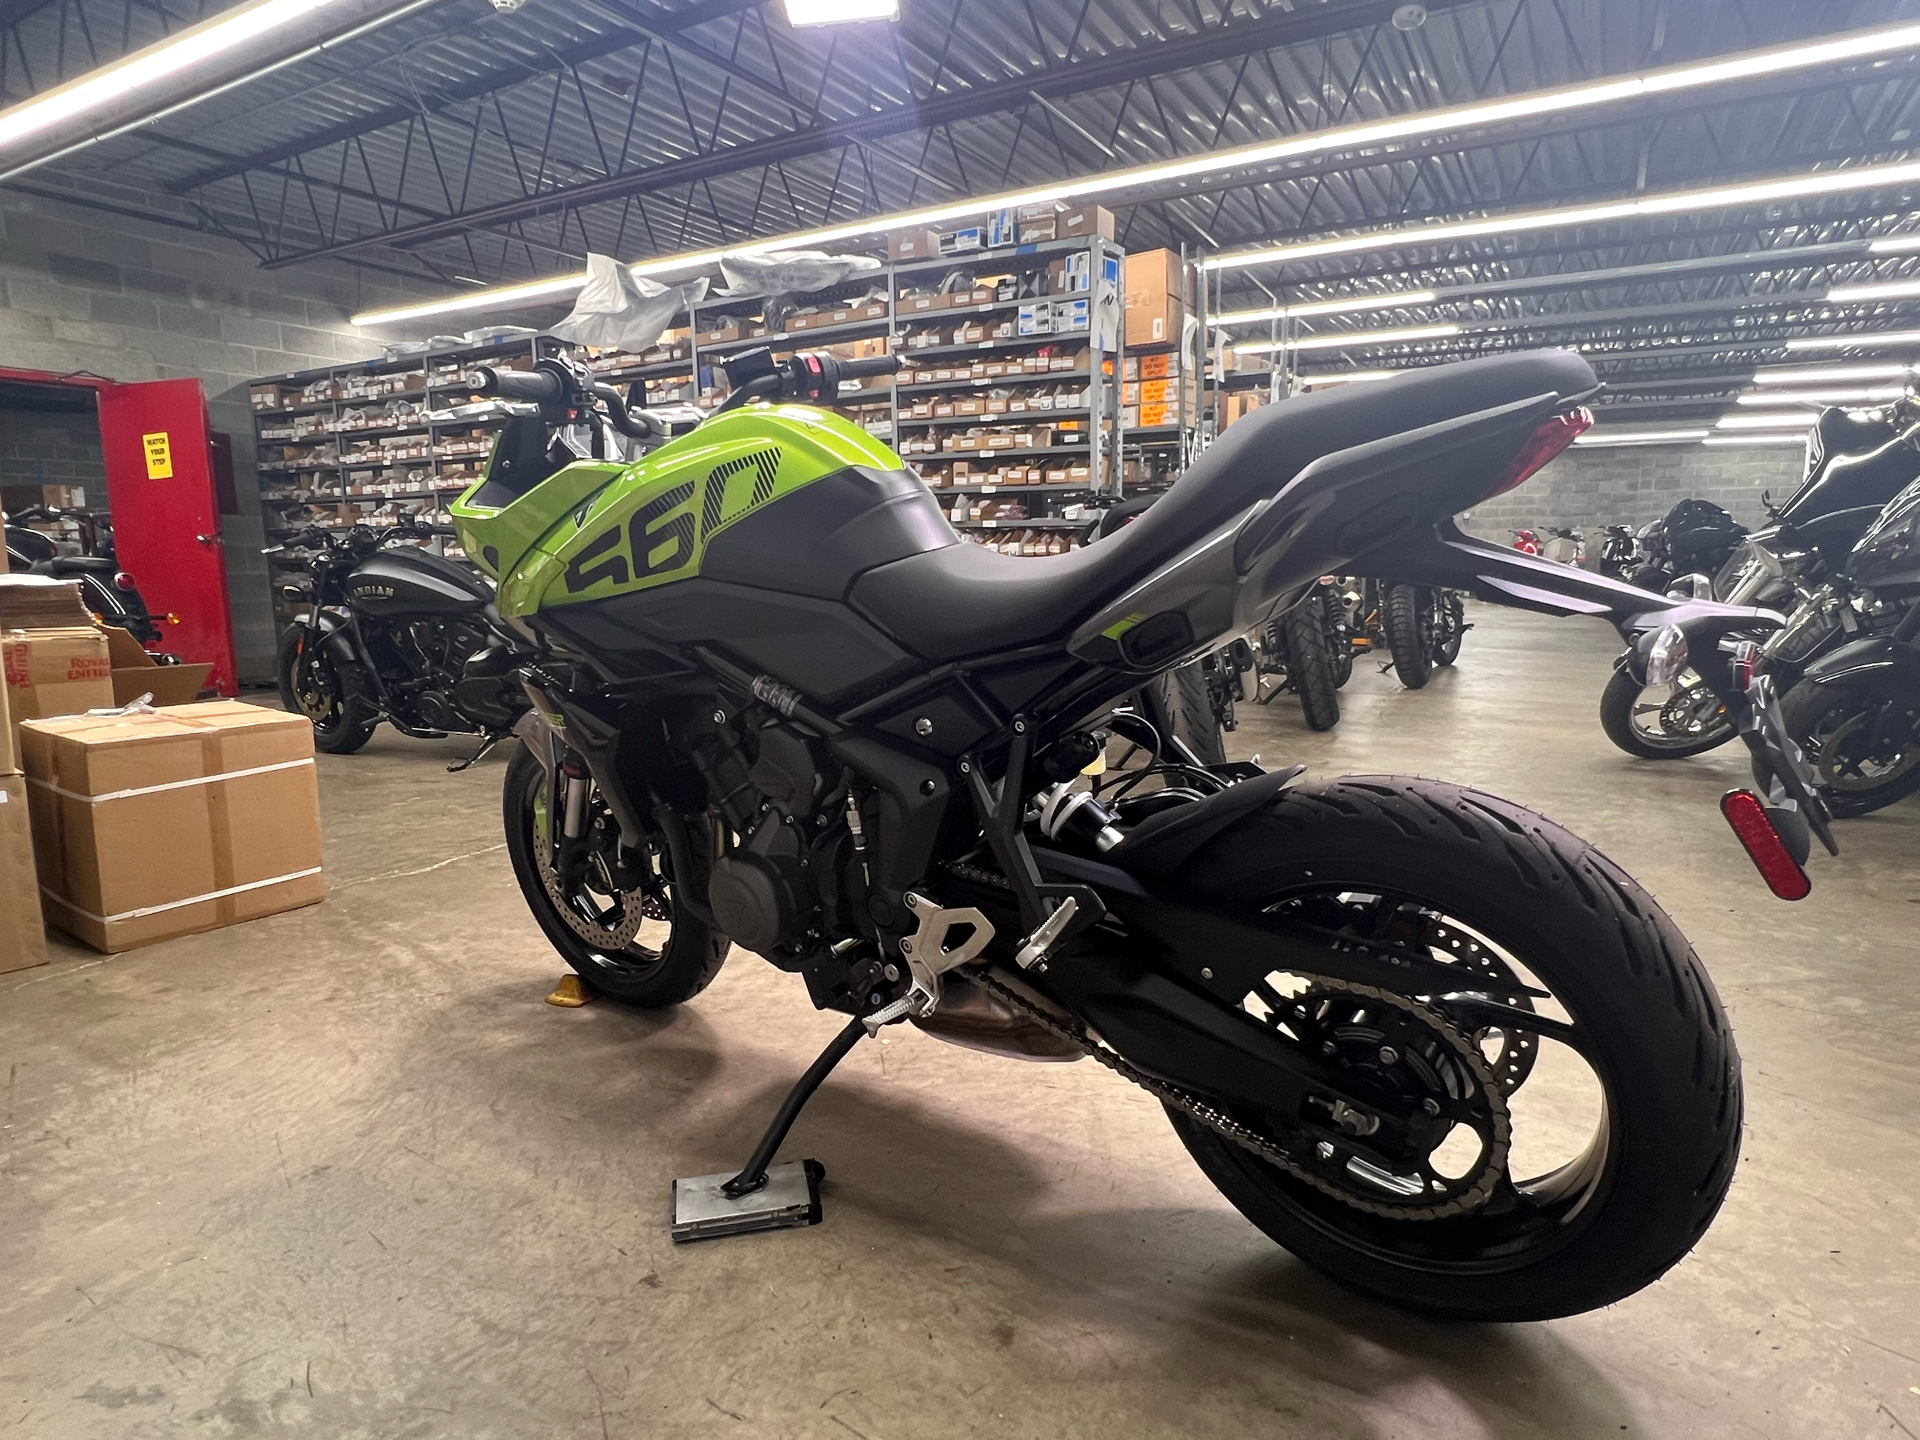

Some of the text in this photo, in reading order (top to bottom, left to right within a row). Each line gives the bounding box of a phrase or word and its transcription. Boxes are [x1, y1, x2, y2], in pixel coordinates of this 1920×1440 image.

[146, 437, 166, 446] WATCH
[150, 447, 166, 456] YOUR
[152, 457, 166, 467] STEP
[353, 584, 395, 597] INDIAN
